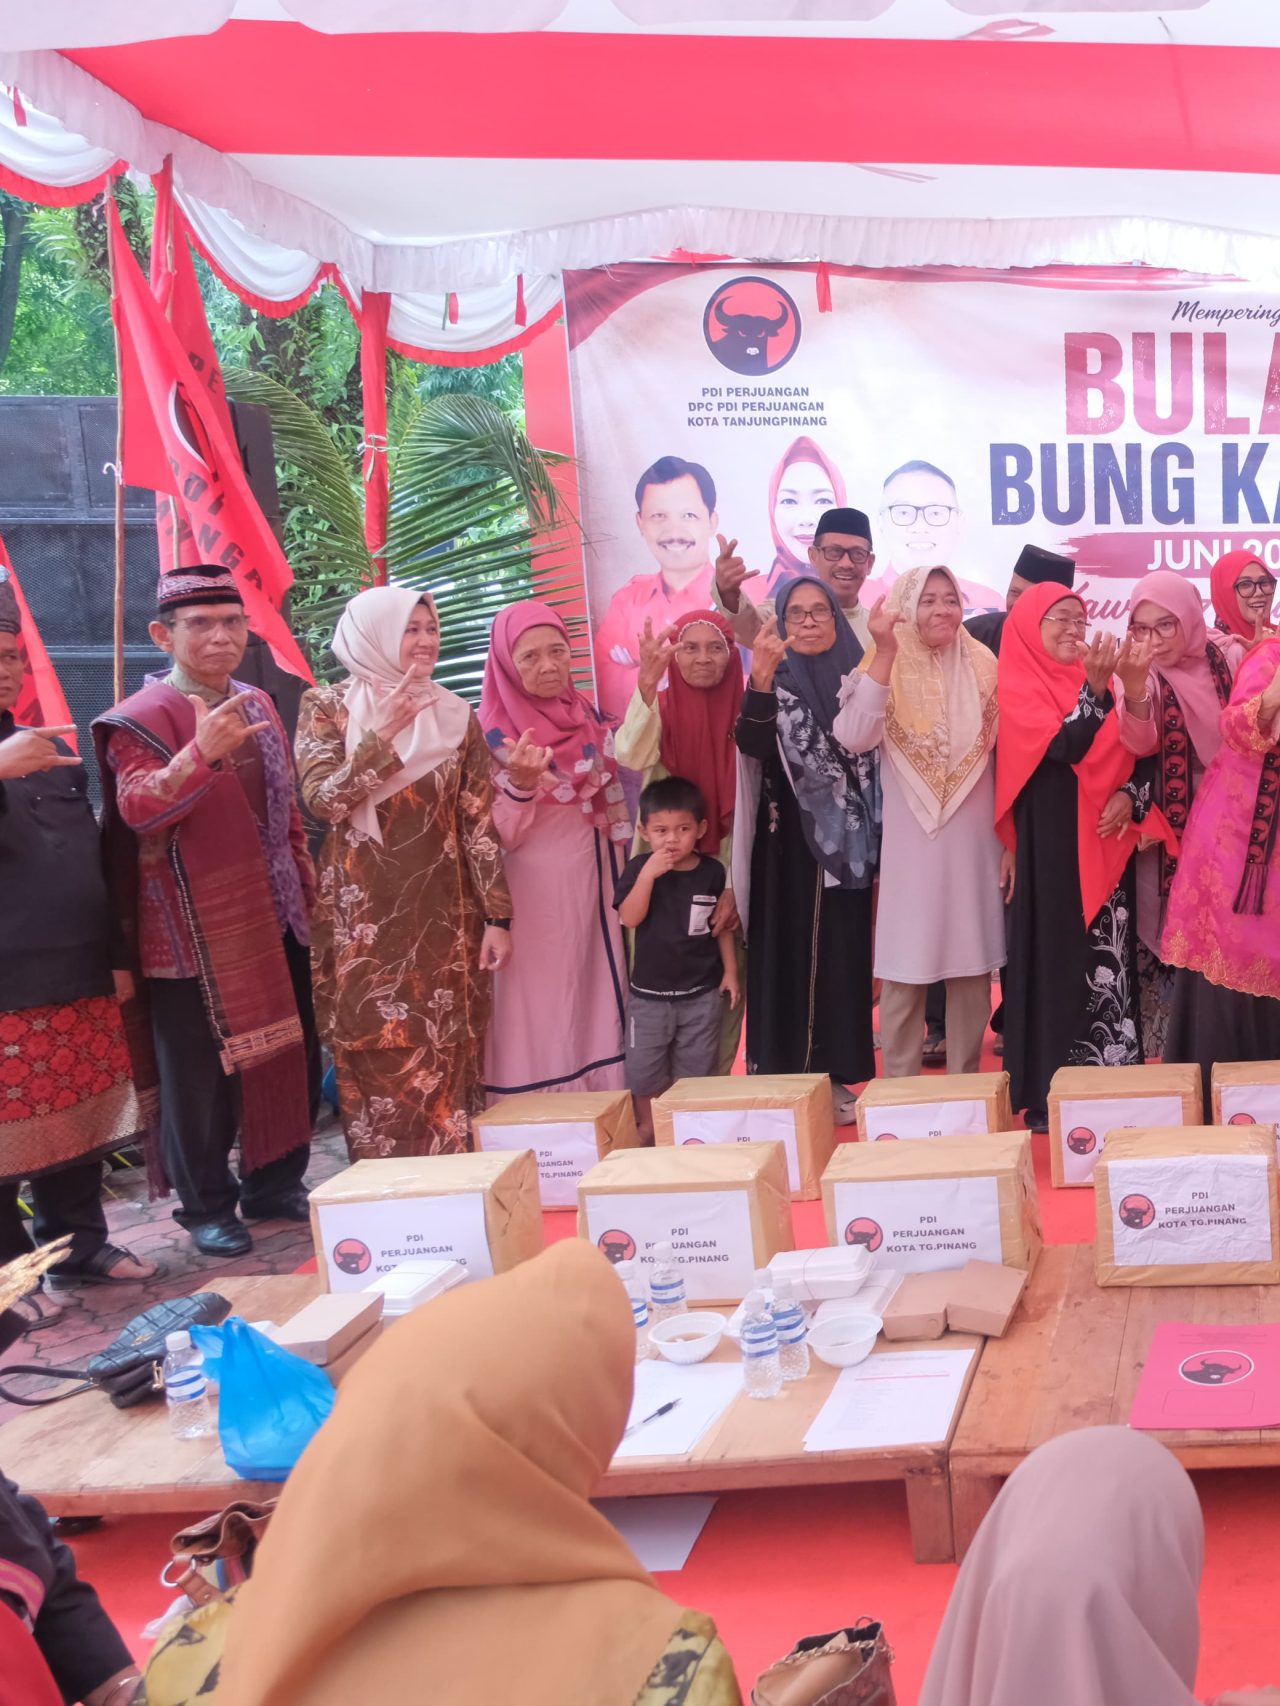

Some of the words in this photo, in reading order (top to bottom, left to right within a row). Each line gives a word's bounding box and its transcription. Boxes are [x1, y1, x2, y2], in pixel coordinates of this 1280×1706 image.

[702, 387, 722, 397] PDI
[726, 387, 809, 397] PERJUANGAN
[688, 402, 713, 412] DPC
[717, 402, 738, 412] PDI
[742, 402, 824, 412] PERJUANGAN
[688, 417, 719, 426] KOTA
[722, 416, 827, 426] TANJUNGPINANG
[990, 442, 1195, 526] BUNG
[537, 1160, 573, 1168] UANGAN
[540, 1170, 583, 1179] TG.PINANG
[1191, 1192, 1209, 1200] PDI
[1165, 1203, 1236, 1215] PERJUANGAN
[919, 1215, 937, 1224] PDI
[1158, 1221, 1188, 1229] KOTA
[1190, 1217, 1247, 1226] TG.PINANG
[671, 1228, 689, 1236] PDI
[892, 1228, 965, 1238] PERJUANGAN
[406, 1234, 424, 1242] PDI
[645, 1240, 717, 1250] PUANGAN
[886, 1245, 916, 1253] KOTA
[919, 1242, 977, 1251] TG.PINANG
[380, 1245, 453, 1258] PERJUANGAN
[674, 1254, 729, 1263] G.PINANG
[375, 1264, 398, 1273] KOT
